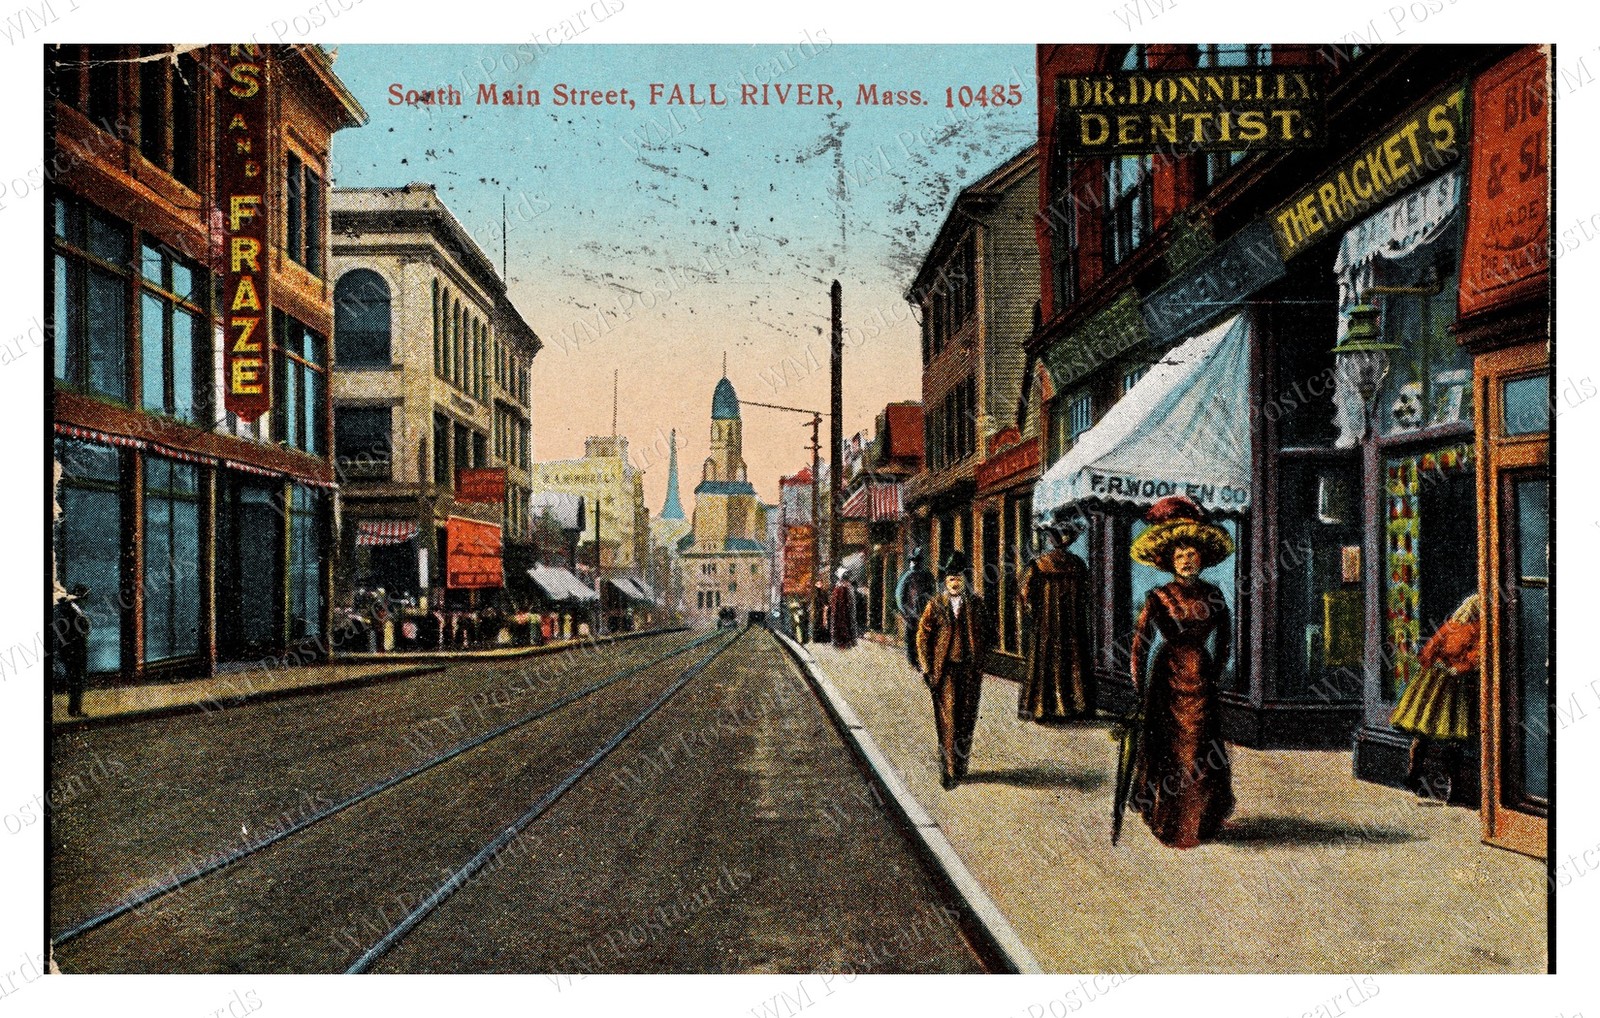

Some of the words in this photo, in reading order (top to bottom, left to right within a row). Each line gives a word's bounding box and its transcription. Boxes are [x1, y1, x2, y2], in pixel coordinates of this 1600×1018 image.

[228, 113, 261, 178] AND
[1078, 109, 1312, 146] DENTIST.
[1277, 193, 1323, 248] THE
[1318, 120, 1425, 222] RACKET
[1484, 199, 1539, 238] MADE
[229, 194, 263, 394] FRAZE
